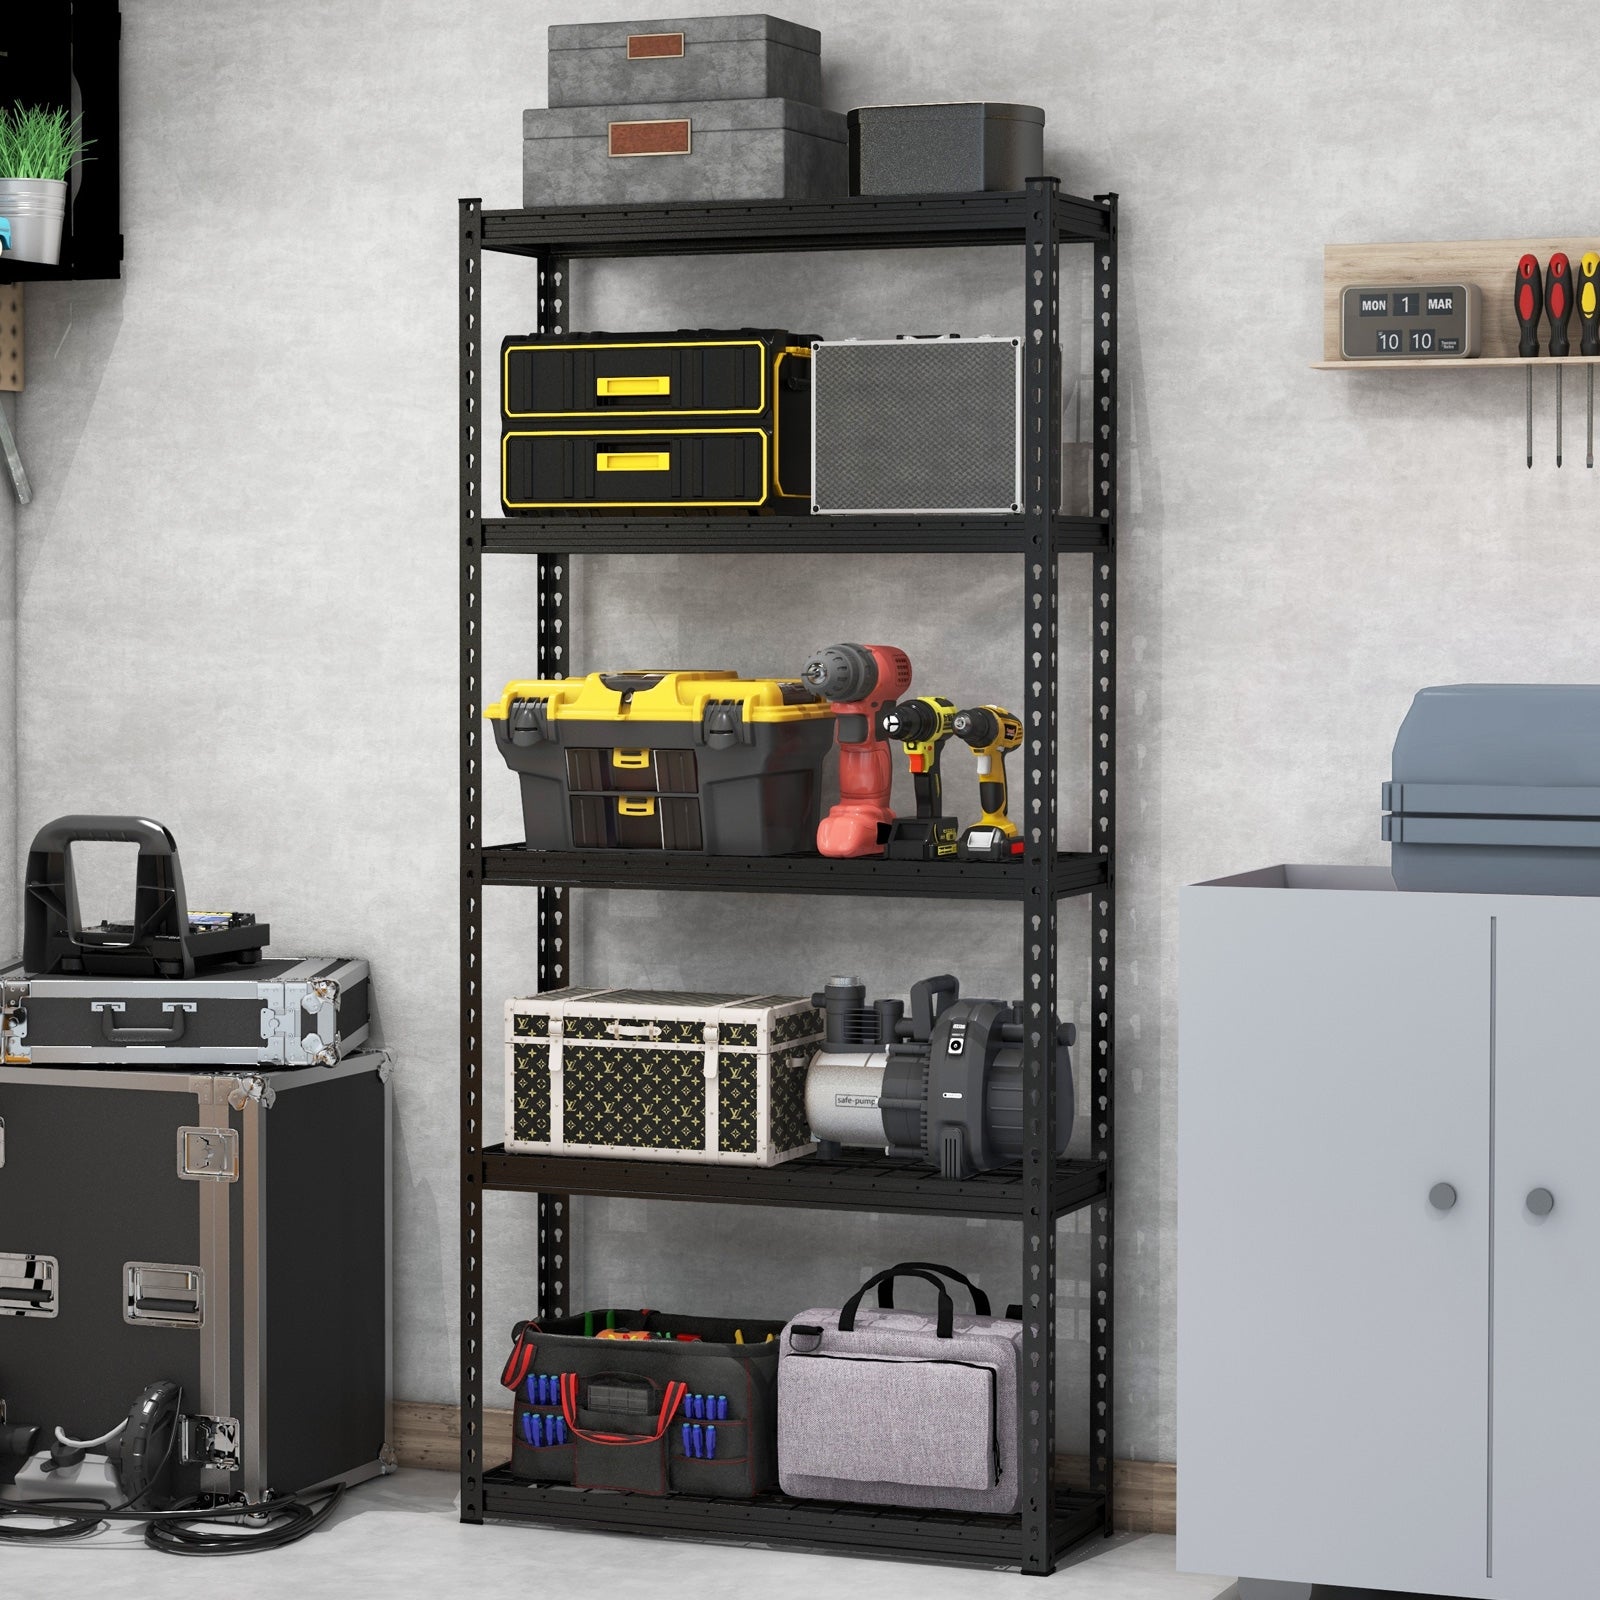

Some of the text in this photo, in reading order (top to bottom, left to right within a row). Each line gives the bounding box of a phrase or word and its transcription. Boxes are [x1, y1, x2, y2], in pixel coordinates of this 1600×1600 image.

[1362, 297, 1452, 312] MON 1 MAR
[1380, 334, 1399, 350] 10
[1412, 333, 1432, 349] 10
[838, 1096, 876, 1106] safe-pump
